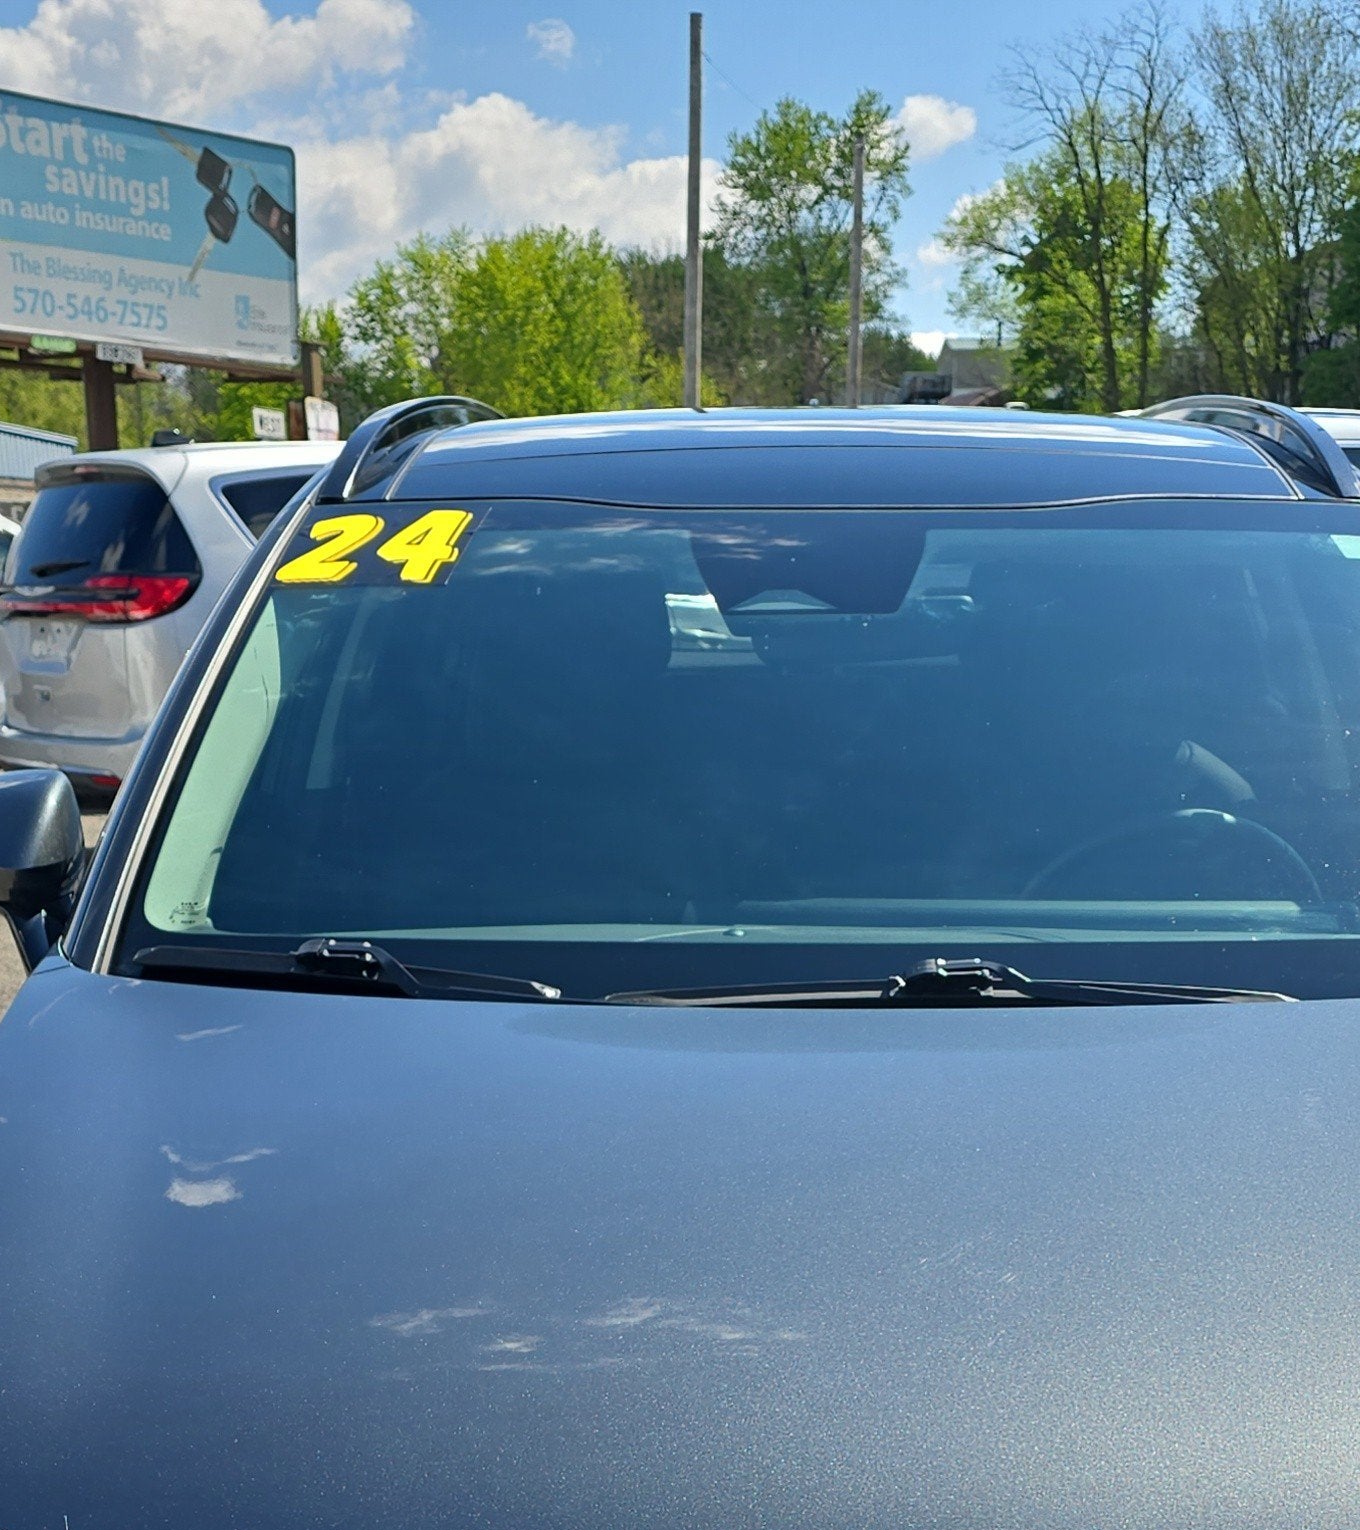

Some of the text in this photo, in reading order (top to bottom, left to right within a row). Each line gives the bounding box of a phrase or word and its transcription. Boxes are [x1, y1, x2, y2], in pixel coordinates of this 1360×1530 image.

[92, 133, 127, 163] the
[45, 163, 170, 217] savings!
[20, 200, 70, 226] auto
[74, 203, 172, 242] insurance
[10, 252, 42, 277] The
[45, 257, 113, 292] Blessing
[117, 267, 175, 299] Agency
[13, 285, 169, 332] 570-546-7575
[275, 509, 473, 584] 24
